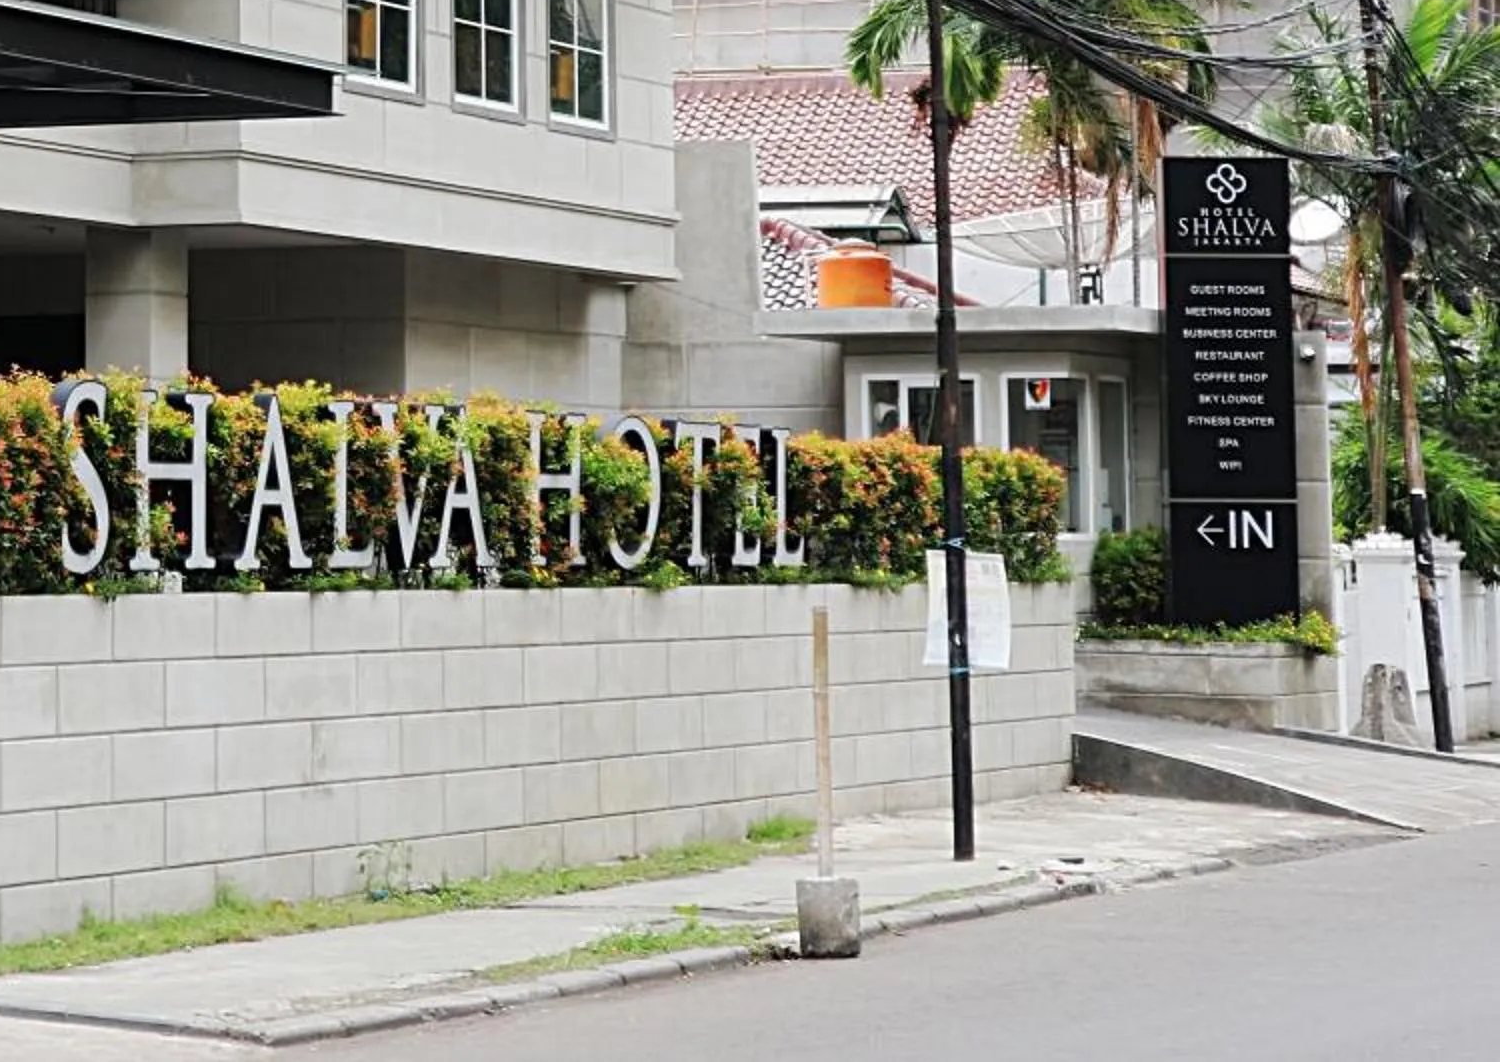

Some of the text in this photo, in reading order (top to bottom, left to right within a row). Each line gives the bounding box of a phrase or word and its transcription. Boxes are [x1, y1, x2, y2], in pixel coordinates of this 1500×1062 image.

[1200, 207, 1255, 217] HOTEL
[1178, 217, 1276, 237] SHALVA
[1194, 237, 1261, 246] JAKARTA
[1190, 285, 1265, 295] GUEST ROOMS
[1185, 306, 1272, 317] MEETING ROOMS
[1183, 328, 1277, 338] BUSINESS CENTER
[1195, 350, 1264, 360] RESTAURANT
[1193, 371, 1269, 383] COFFEE SHOP
[1199, 394, 1265, 405] SKY LOUNGE
[1187, 415, 1275, 426] FITNESS CENTER
[1219, 438, 1239, 447] SPA
[53, 379, 805, 574] SHALVA HOTEL
[1228, 510, 1274, 550] IN
